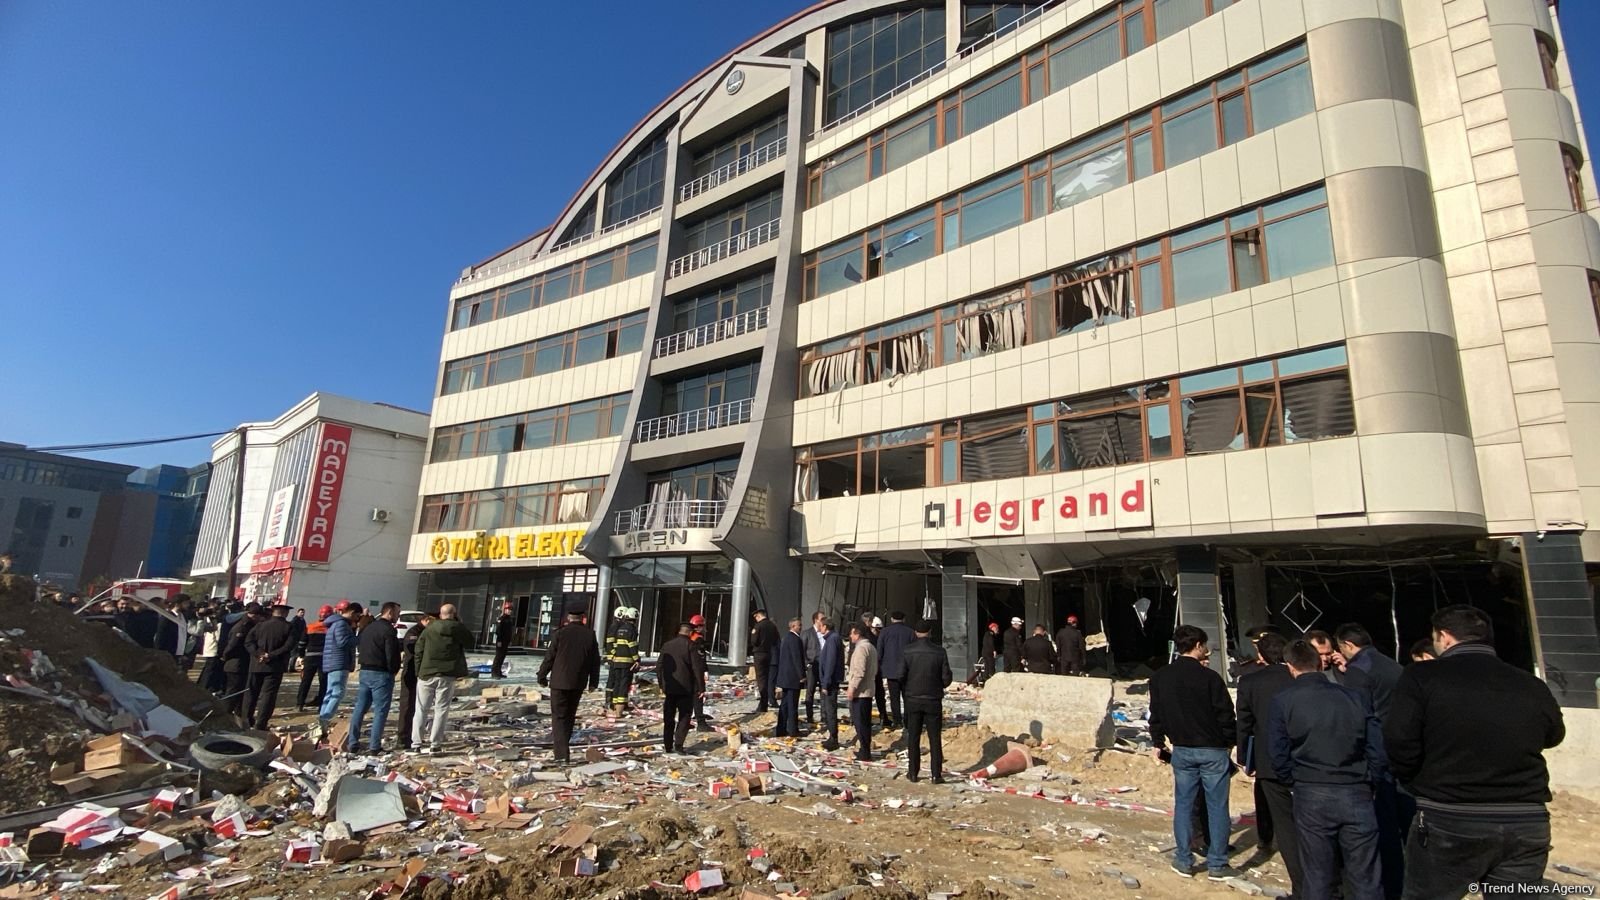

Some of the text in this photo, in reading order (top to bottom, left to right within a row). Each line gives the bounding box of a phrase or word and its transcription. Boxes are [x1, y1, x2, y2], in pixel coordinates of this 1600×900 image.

[308, 438, 347, 548] MADEYRA
[955, 479, 1144, 531] legrand
[449, 532, 511, 561] TUĞRA
